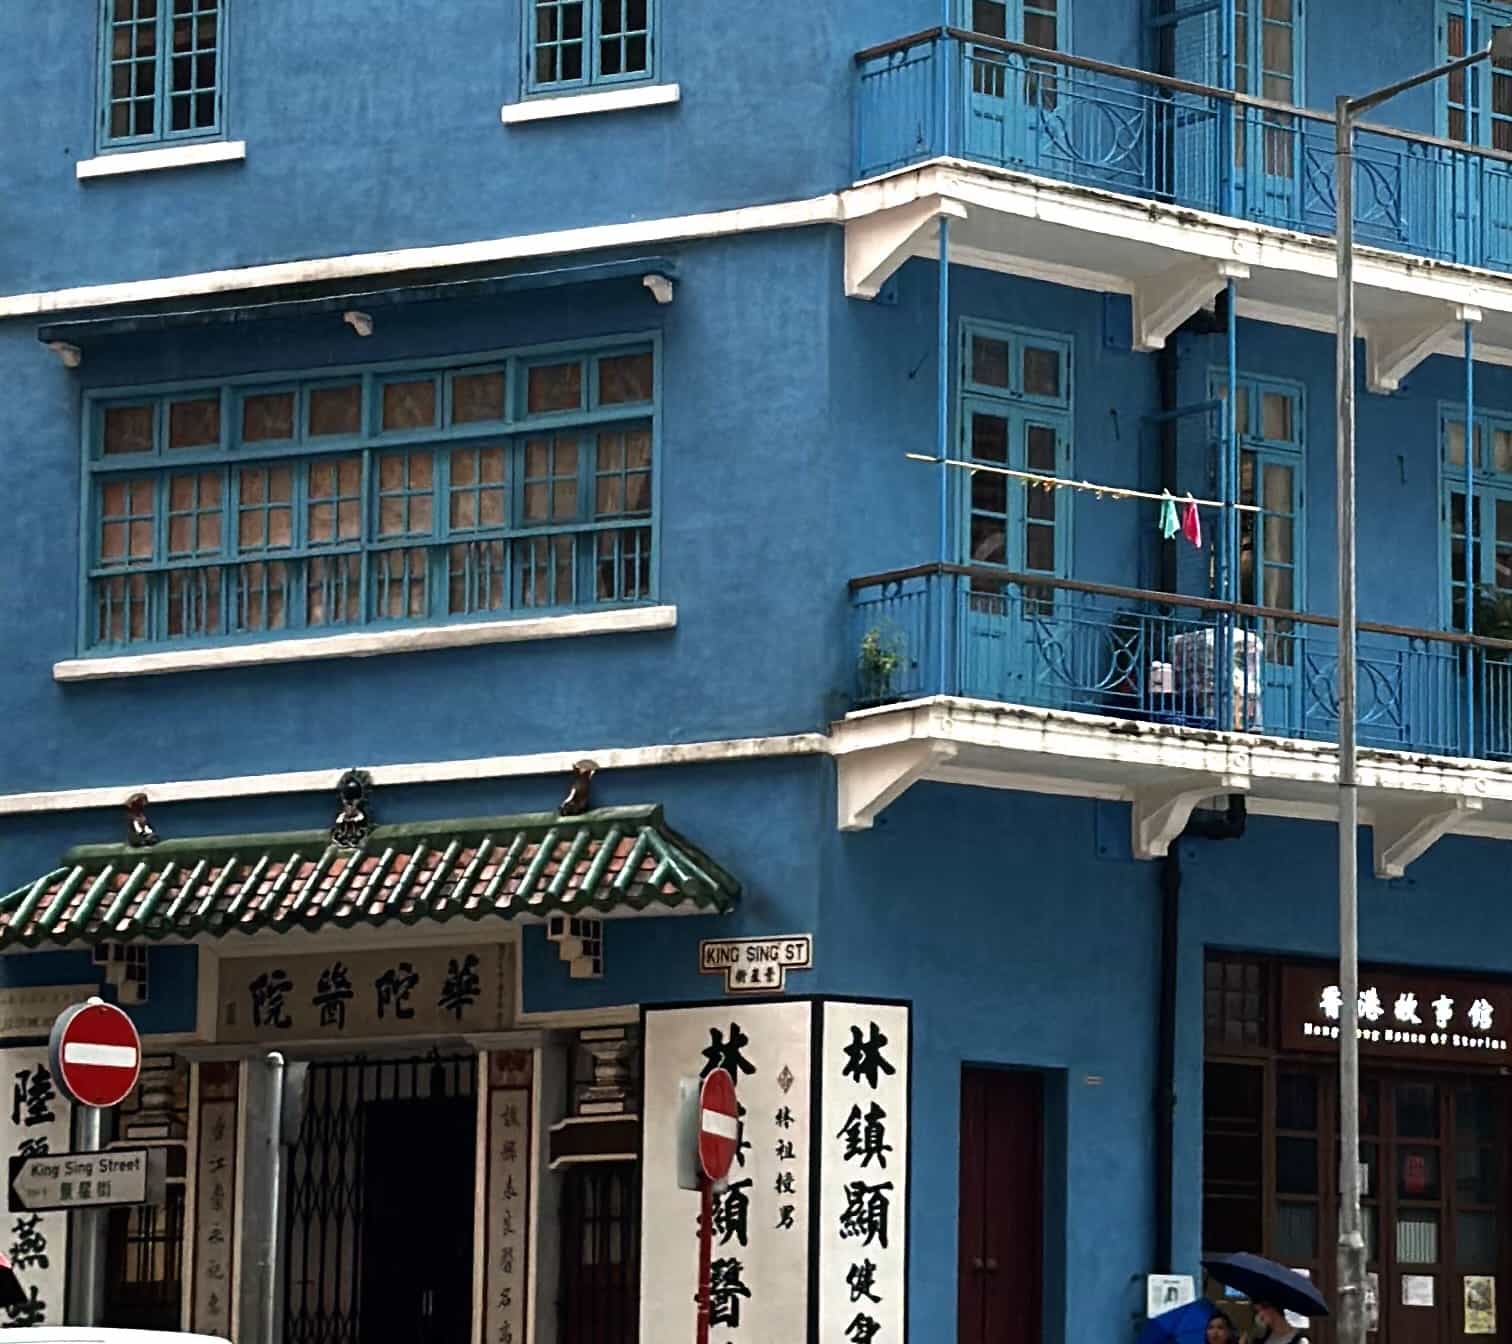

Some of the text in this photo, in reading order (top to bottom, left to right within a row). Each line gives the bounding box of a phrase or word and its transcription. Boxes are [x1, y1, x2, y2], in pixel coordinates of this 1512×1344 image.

[706, 943, 805, 964] KING SING ST
[1303, 1022, 1340, 1039] Hong
[1352, 1028, 1380, 1042] ong
[1384, 1029, 1426, 1044] House
[1452, 1034, 1508, 1050] Stories
[31, 1158, 141, 1180] King Sing Street
